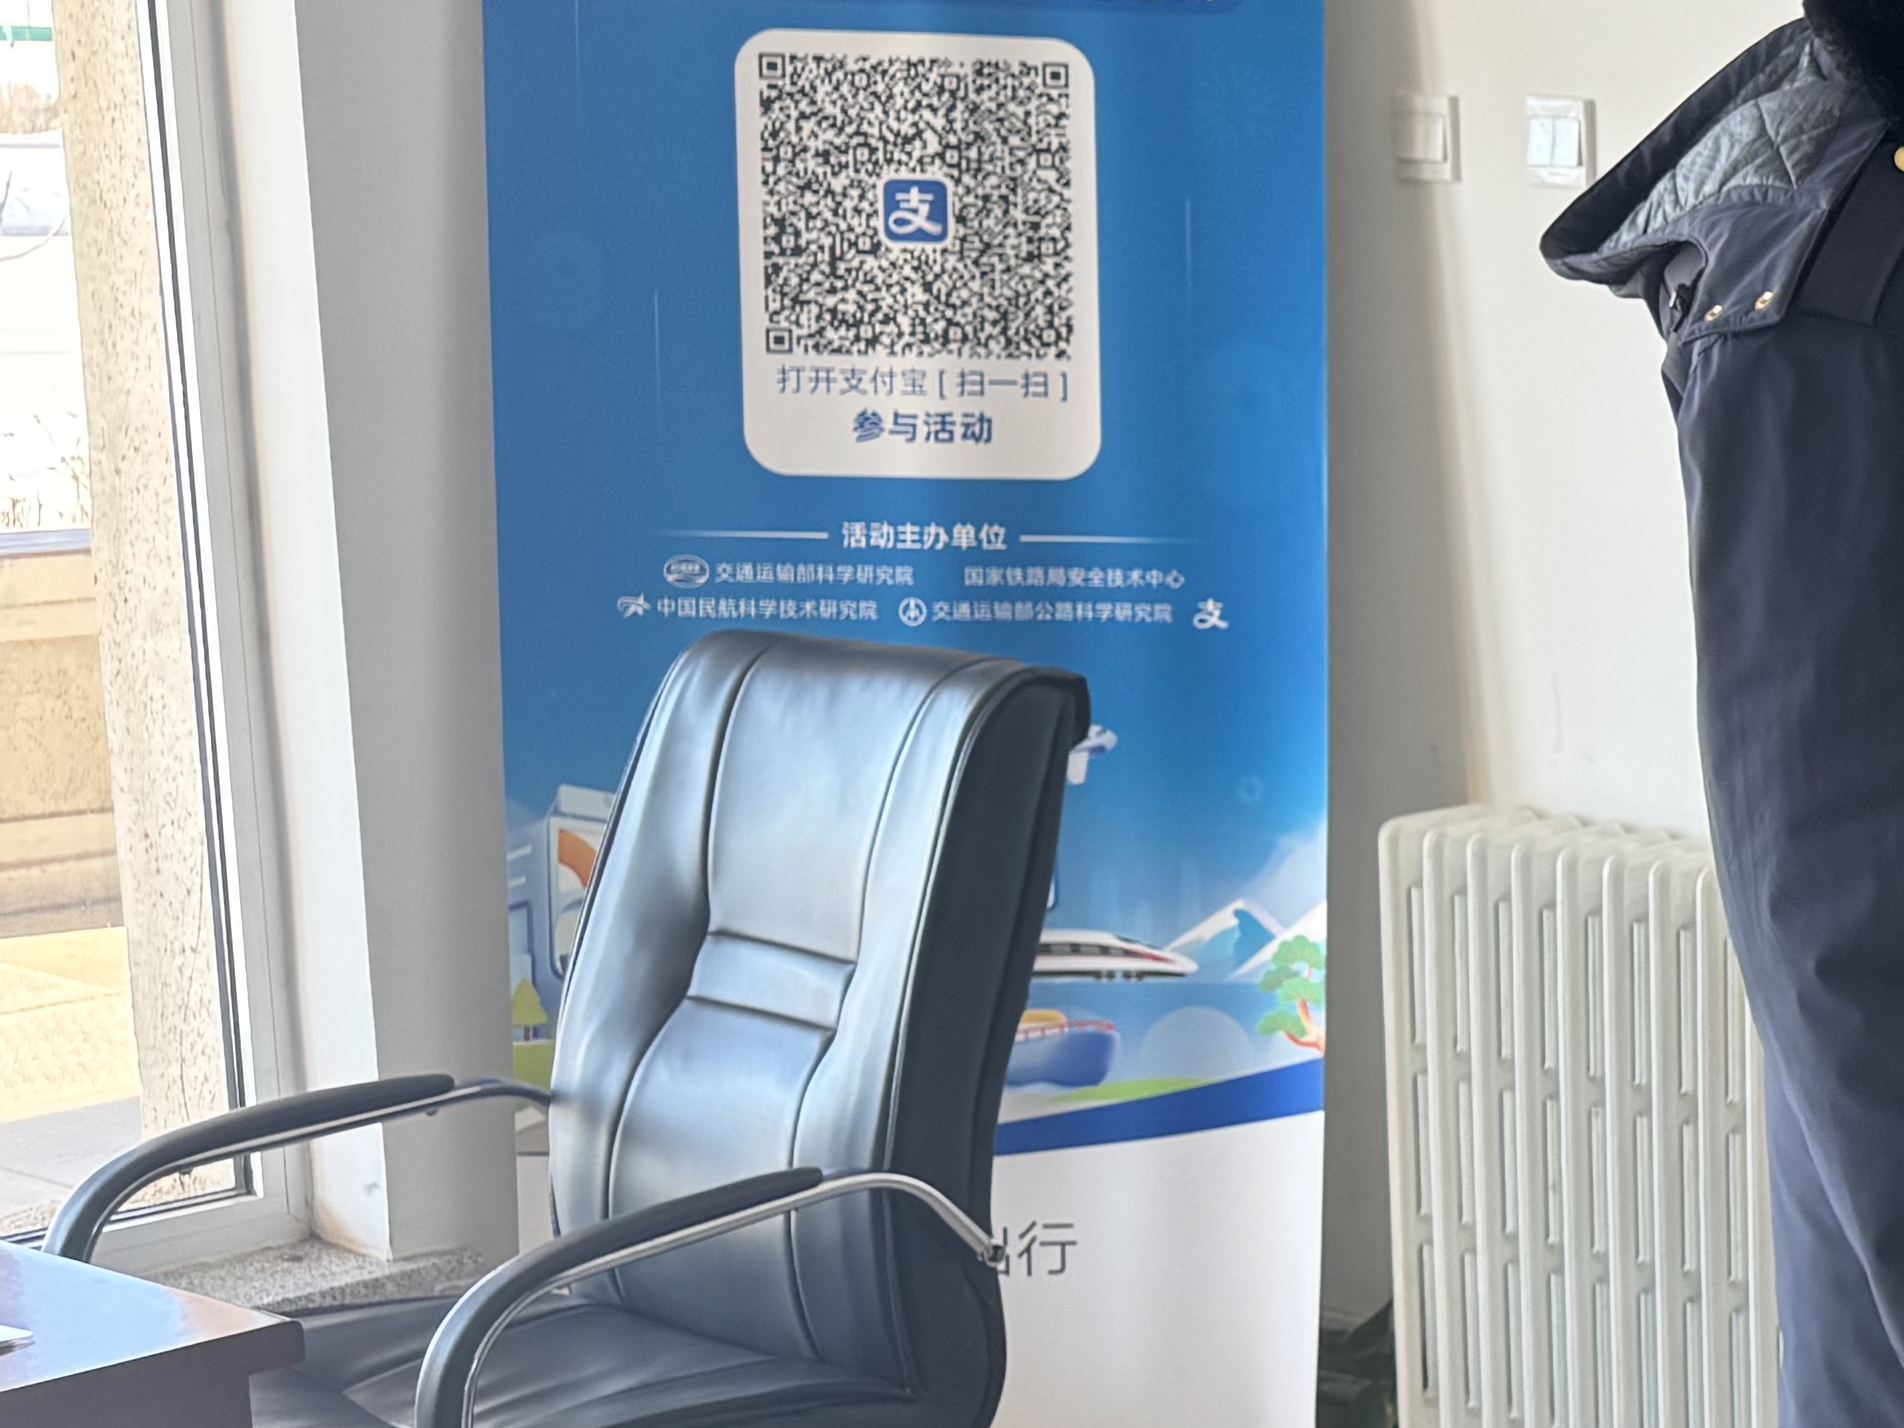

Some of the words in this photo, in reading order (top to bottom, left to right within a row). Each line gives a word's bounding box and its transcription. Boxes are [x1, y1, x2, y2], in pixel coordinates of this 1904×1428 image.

[851, 408, 993, 446] 参与活动
[841, 521, 1008, 551] 活动主办单位
[715, 562, 915, 587] 交通运输部科学研究院
[657, 596, 879, 621] 中国民航科学技术研究院
